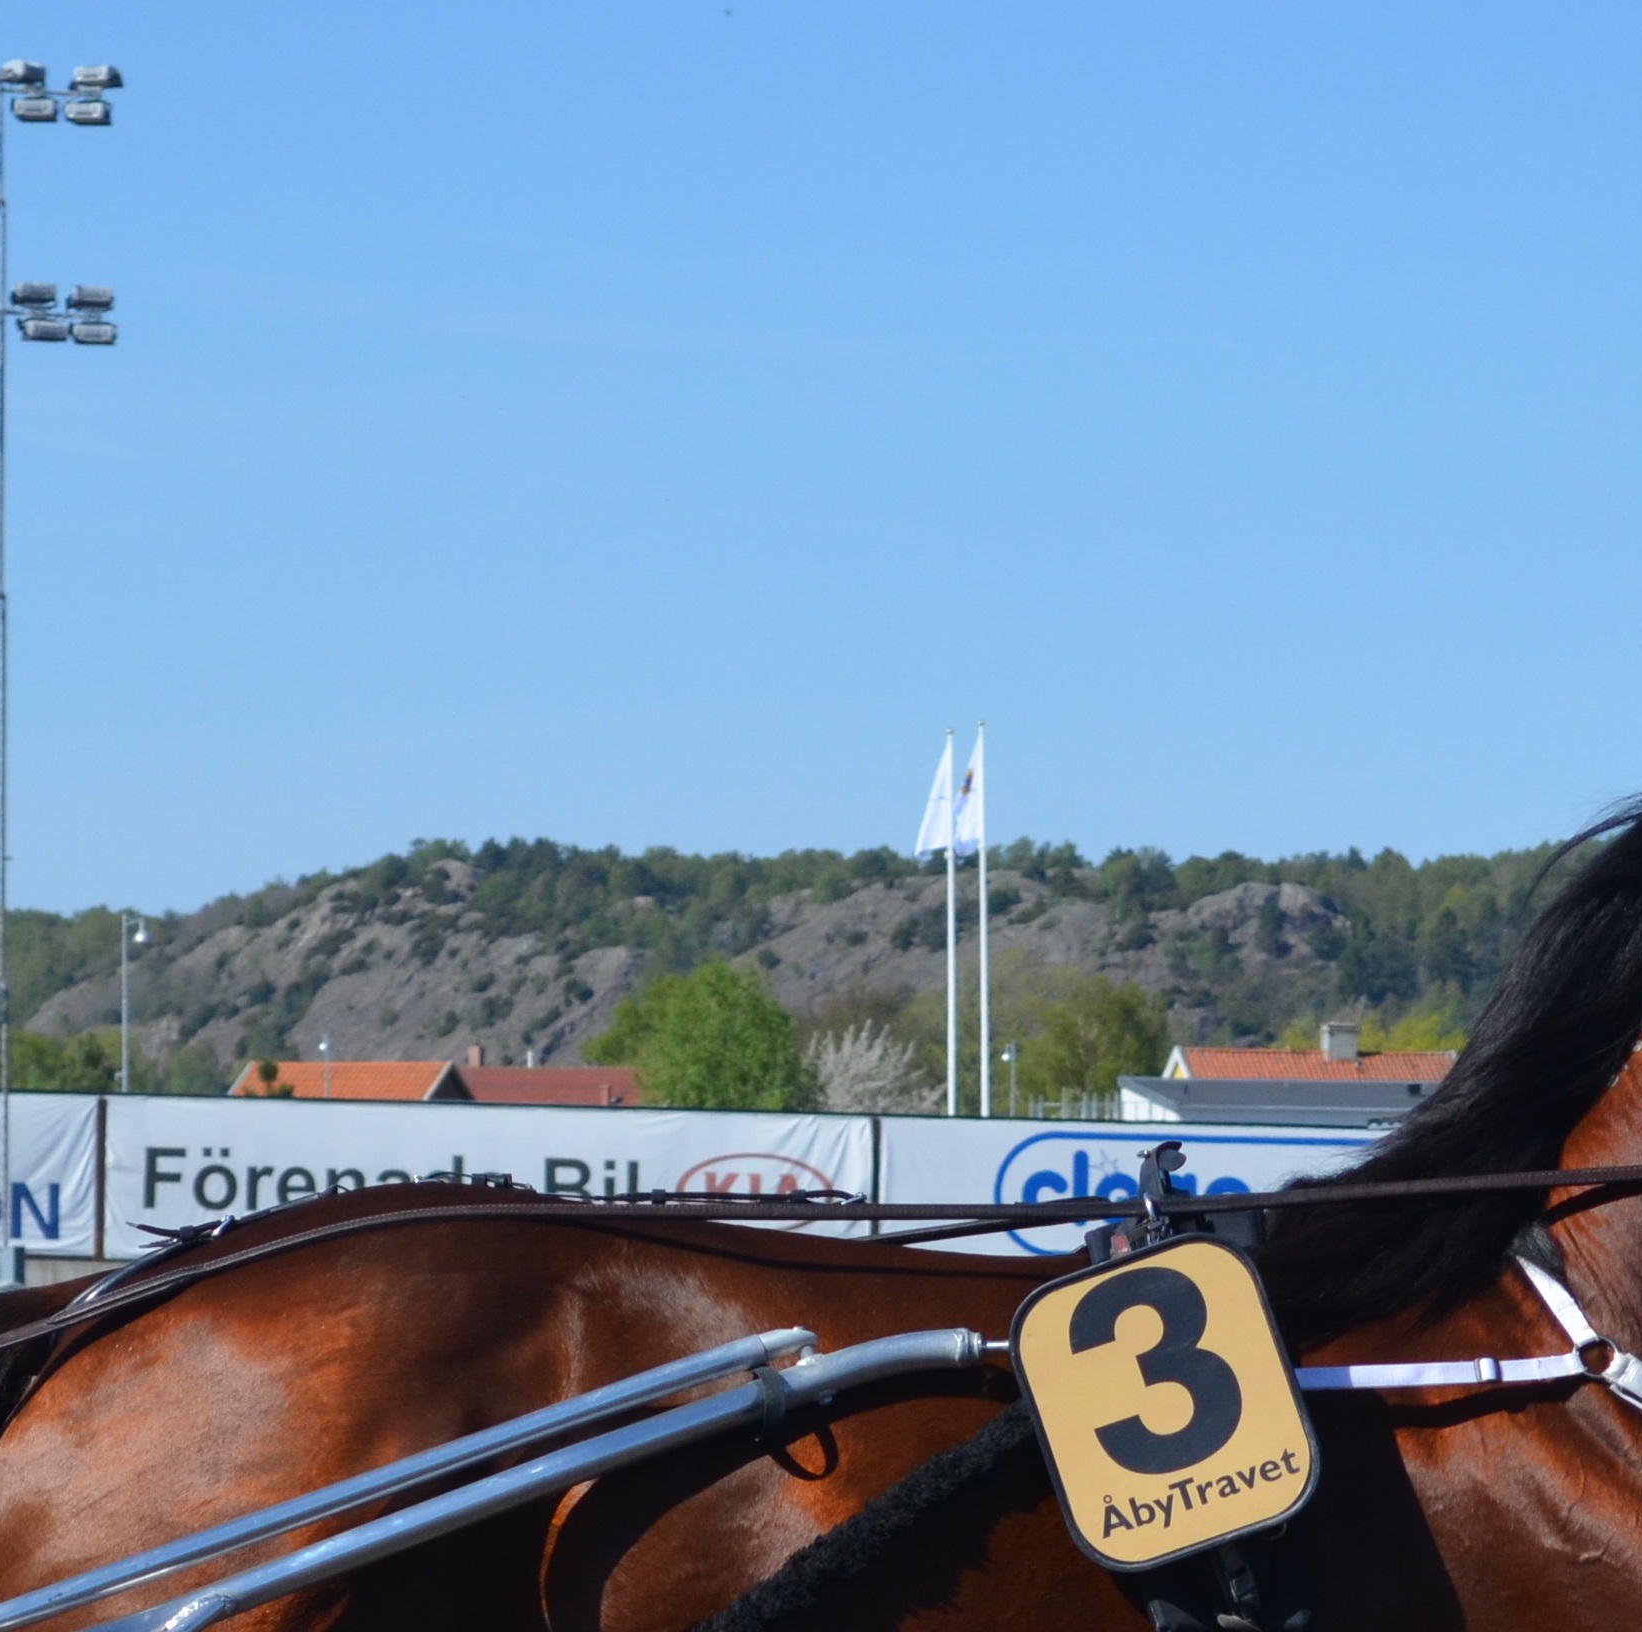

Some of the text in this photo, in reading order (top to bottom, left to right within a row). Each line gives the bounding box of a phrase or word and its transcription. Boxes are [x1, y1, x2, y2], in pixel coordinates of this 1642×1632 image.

[144, 1147, 640, 1210] Fören Bil
[703, 1171, 800, 1198] KIA
[1069, 1266, 1243, 1475] 3
[1101, 1448, 1301, 1539] ÅbyTravet
